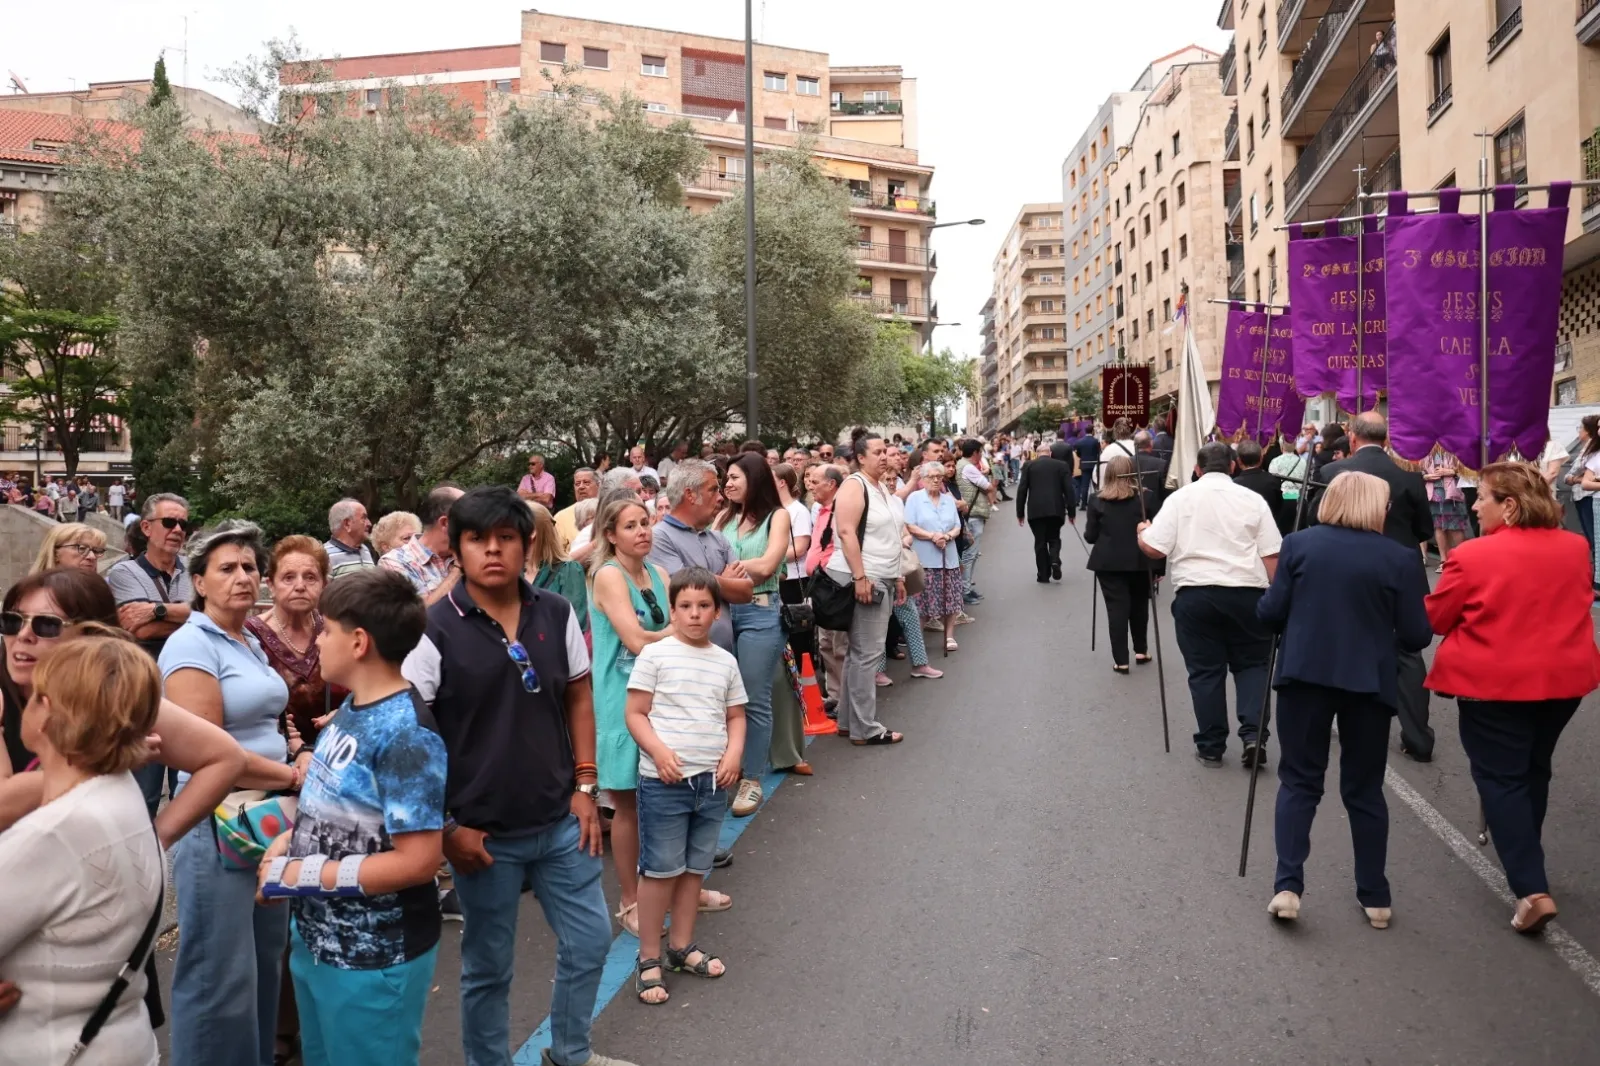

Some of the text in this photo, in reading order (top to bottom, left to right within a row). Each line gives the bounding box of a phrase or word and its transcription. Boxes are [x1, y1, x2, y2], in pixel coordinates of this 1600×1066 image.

[1312, 322, 1335, 336] CON
[1341, 322, 1358, 336] LA
[1440, 336, 1513, 356] CAE LA
[1327, 354, 1385, 369] CUESTAS
[1228, 367, 1240, 378] ES
[1456, 386, 1490, 406] VE
